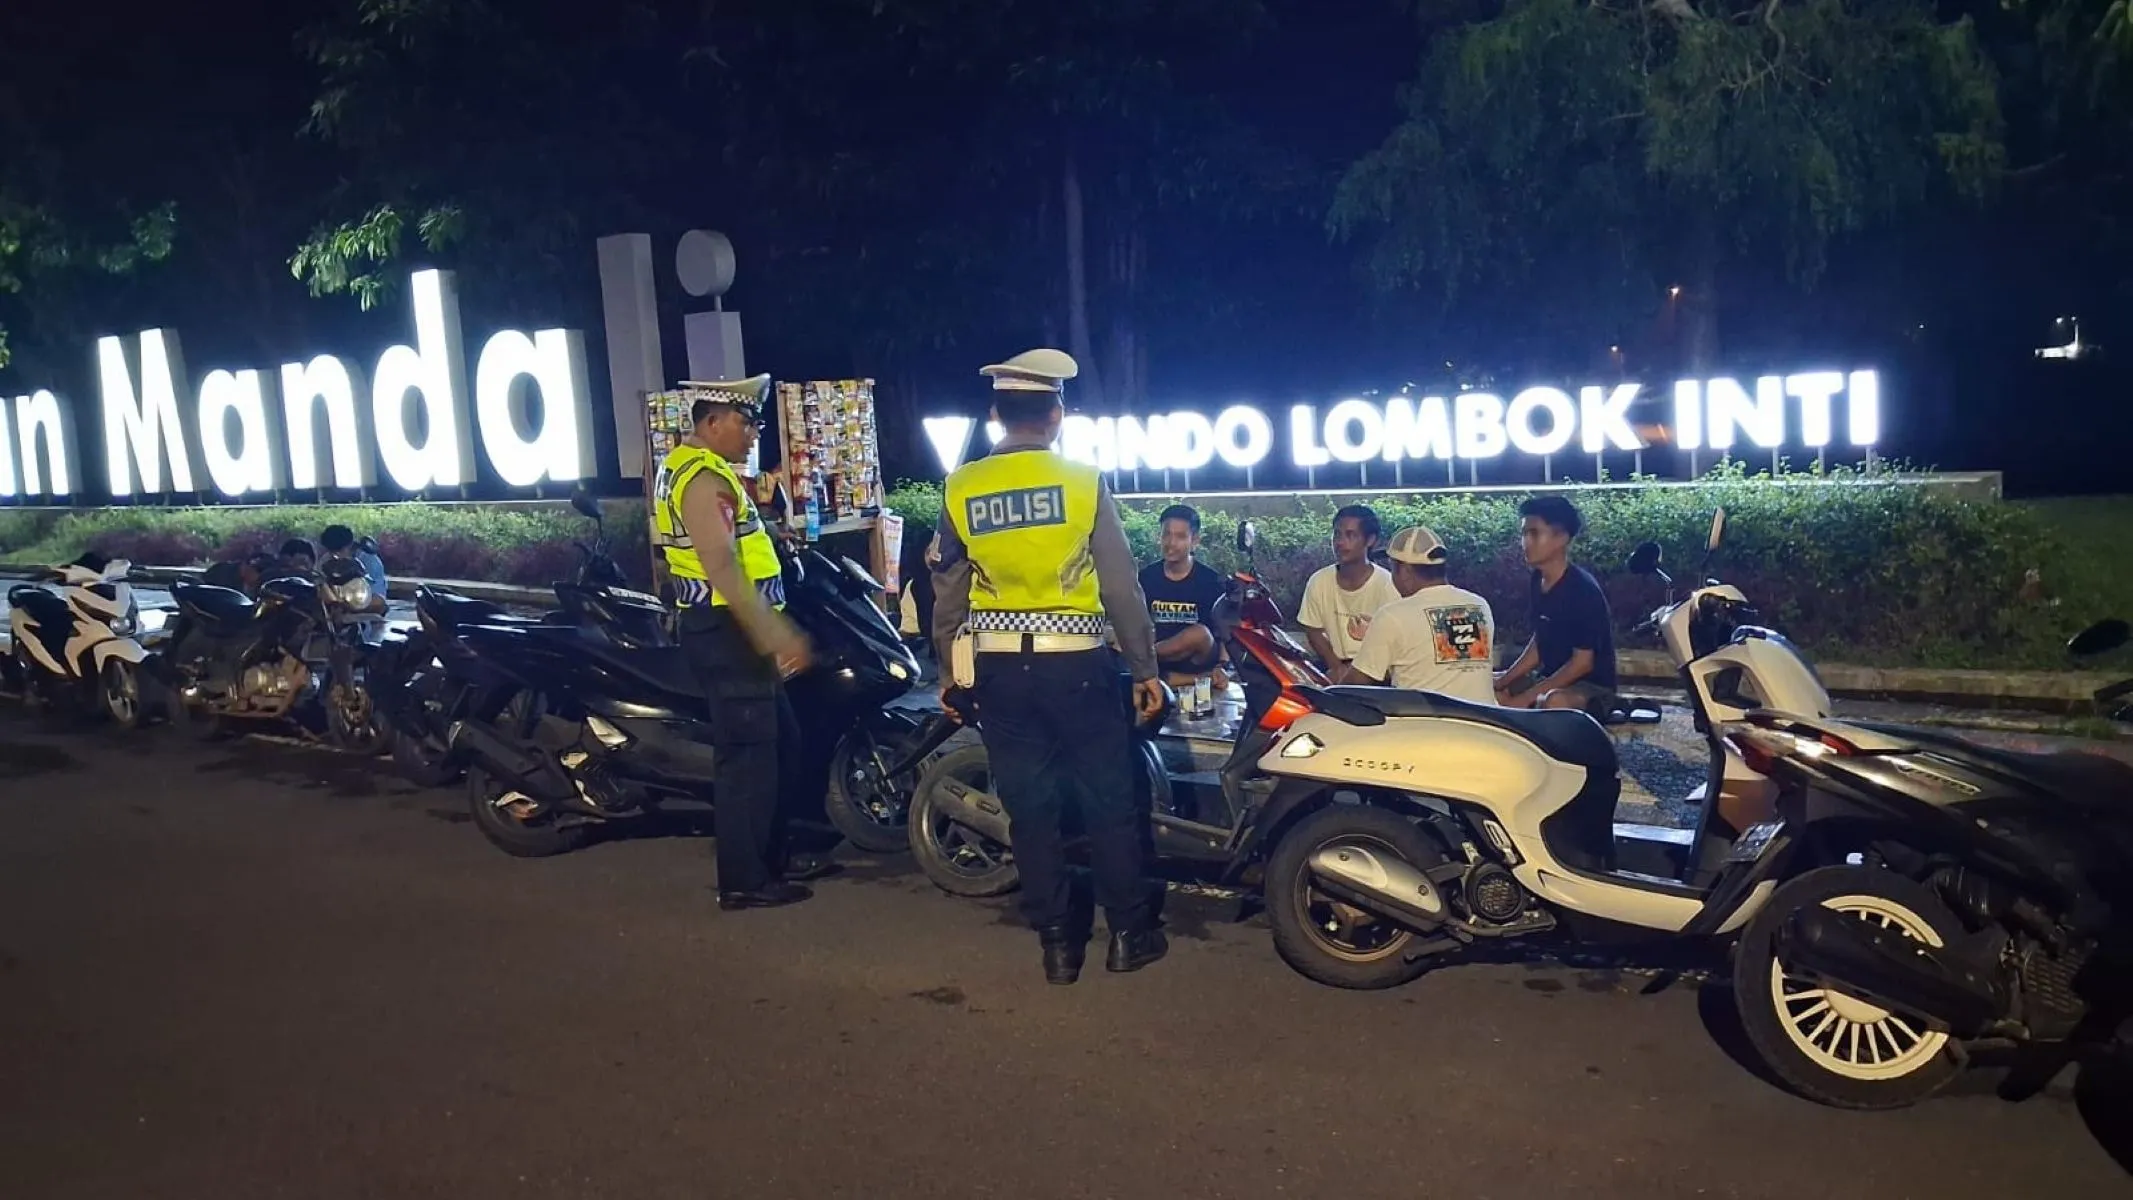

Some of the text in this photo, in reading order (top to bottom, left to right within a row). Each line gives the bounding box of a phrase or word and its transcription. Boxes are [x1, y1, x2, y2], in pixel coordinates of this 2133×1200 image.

[0, 389, 69, 497] n
[1291, 384, 1643, 466] LOMBOK
[1673, 369, 1879, 450] INTI
[970, 491, 1062, 529] POLISI
